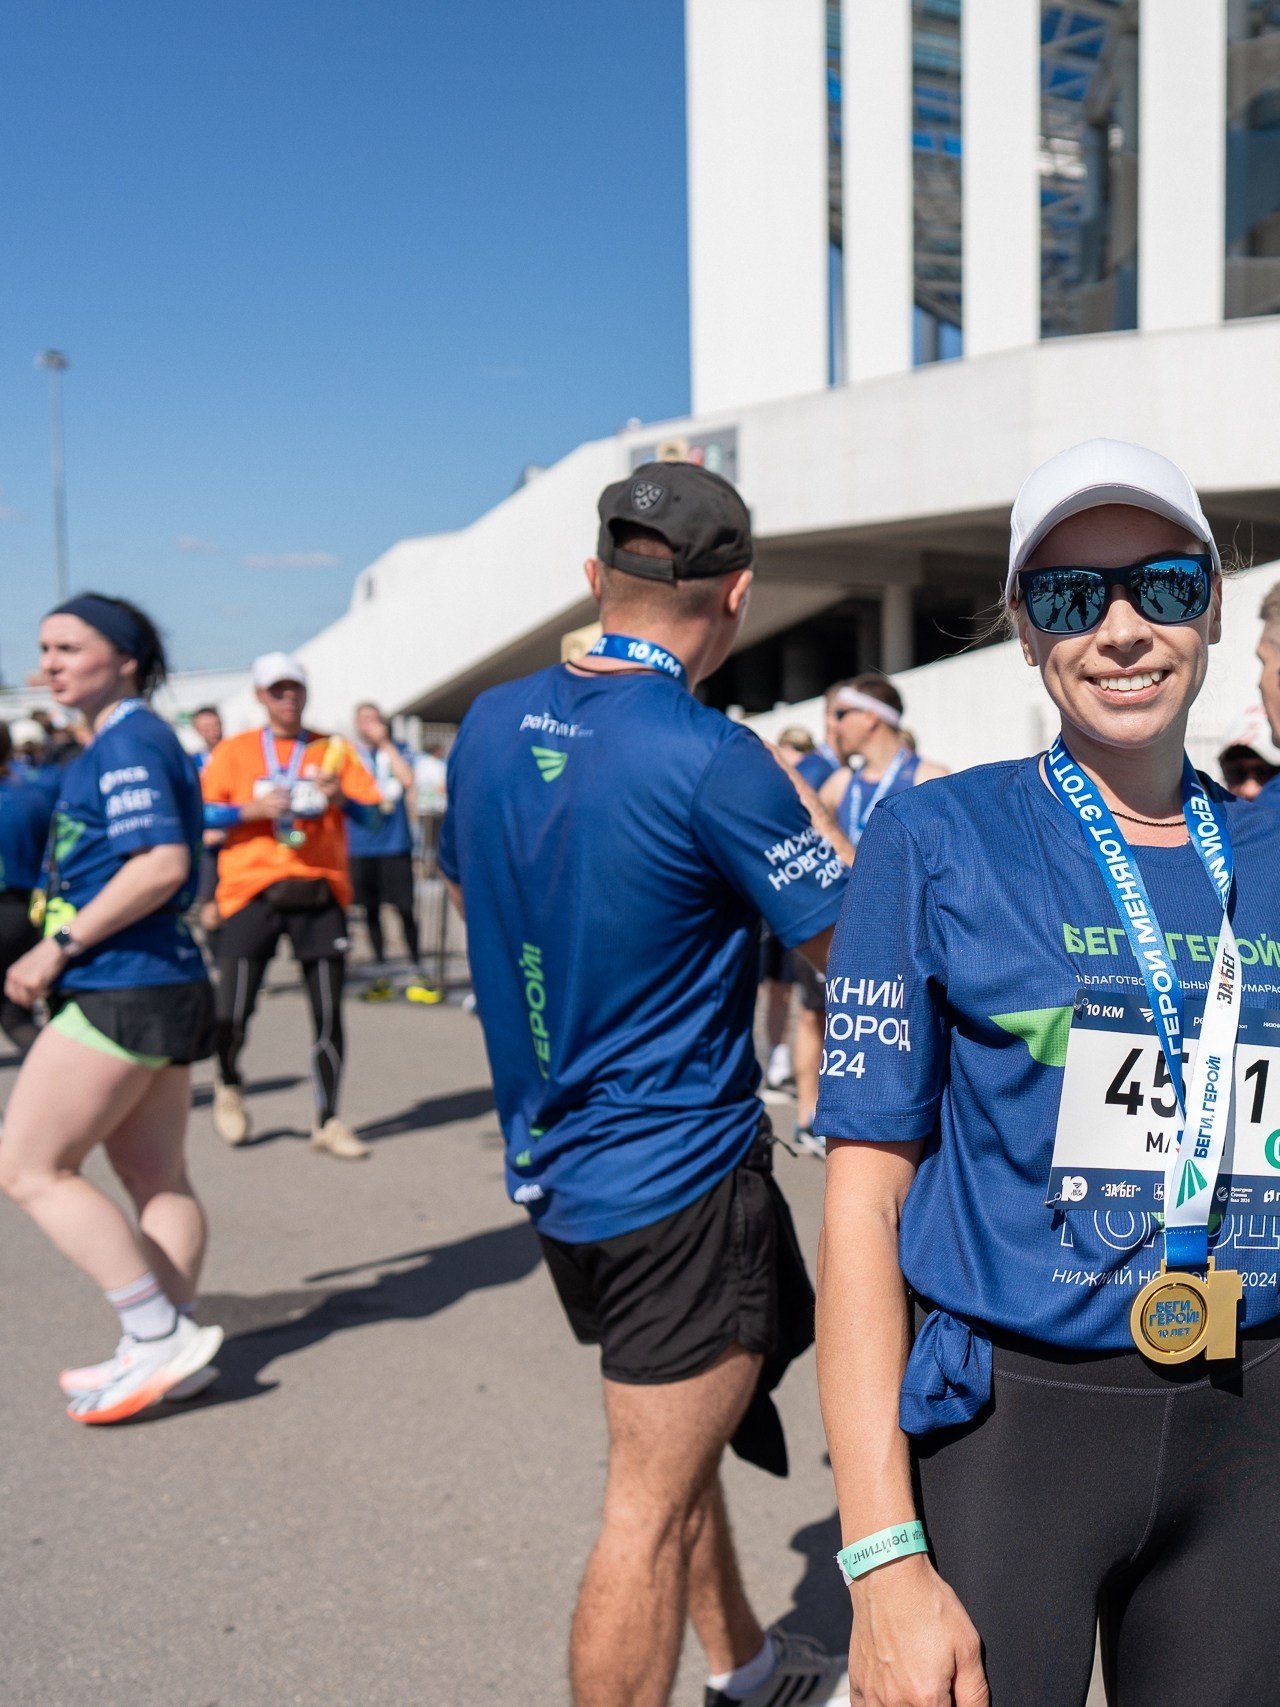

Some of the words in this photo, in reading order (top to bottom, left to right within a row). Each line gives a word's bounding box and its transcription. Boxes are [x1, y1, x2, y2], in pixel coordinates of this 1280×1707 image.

[627, 641, 651, 660] 10
[1053, 763, 1102, 822] ЭТОТ
[1088, 825, 1158, 944] МЕНЯЮТ
[1062, 922, 1136, 956] БЕГ
[1086, 1003, 1101, 1016] 10
[1143, 949, 1181, 1056] ГЕРОИ
[1105, 1047, 1270, 1124] 451
[1202, 1055, 1221, 1112] ГЕРОЙ!
[1194, 1113, 1217, 1158] БЕГИ,
[1242, 1272, 1277, 1287] 2024
[1149, 1310, 1200, 1327] ГЕРОЙ!
[1156, 1301, 1192, 1314] БЕГИ,
[1158, 1330, 1168, 1338] 10
[1170, 1327, 1190, 1337] ЛЕТ
